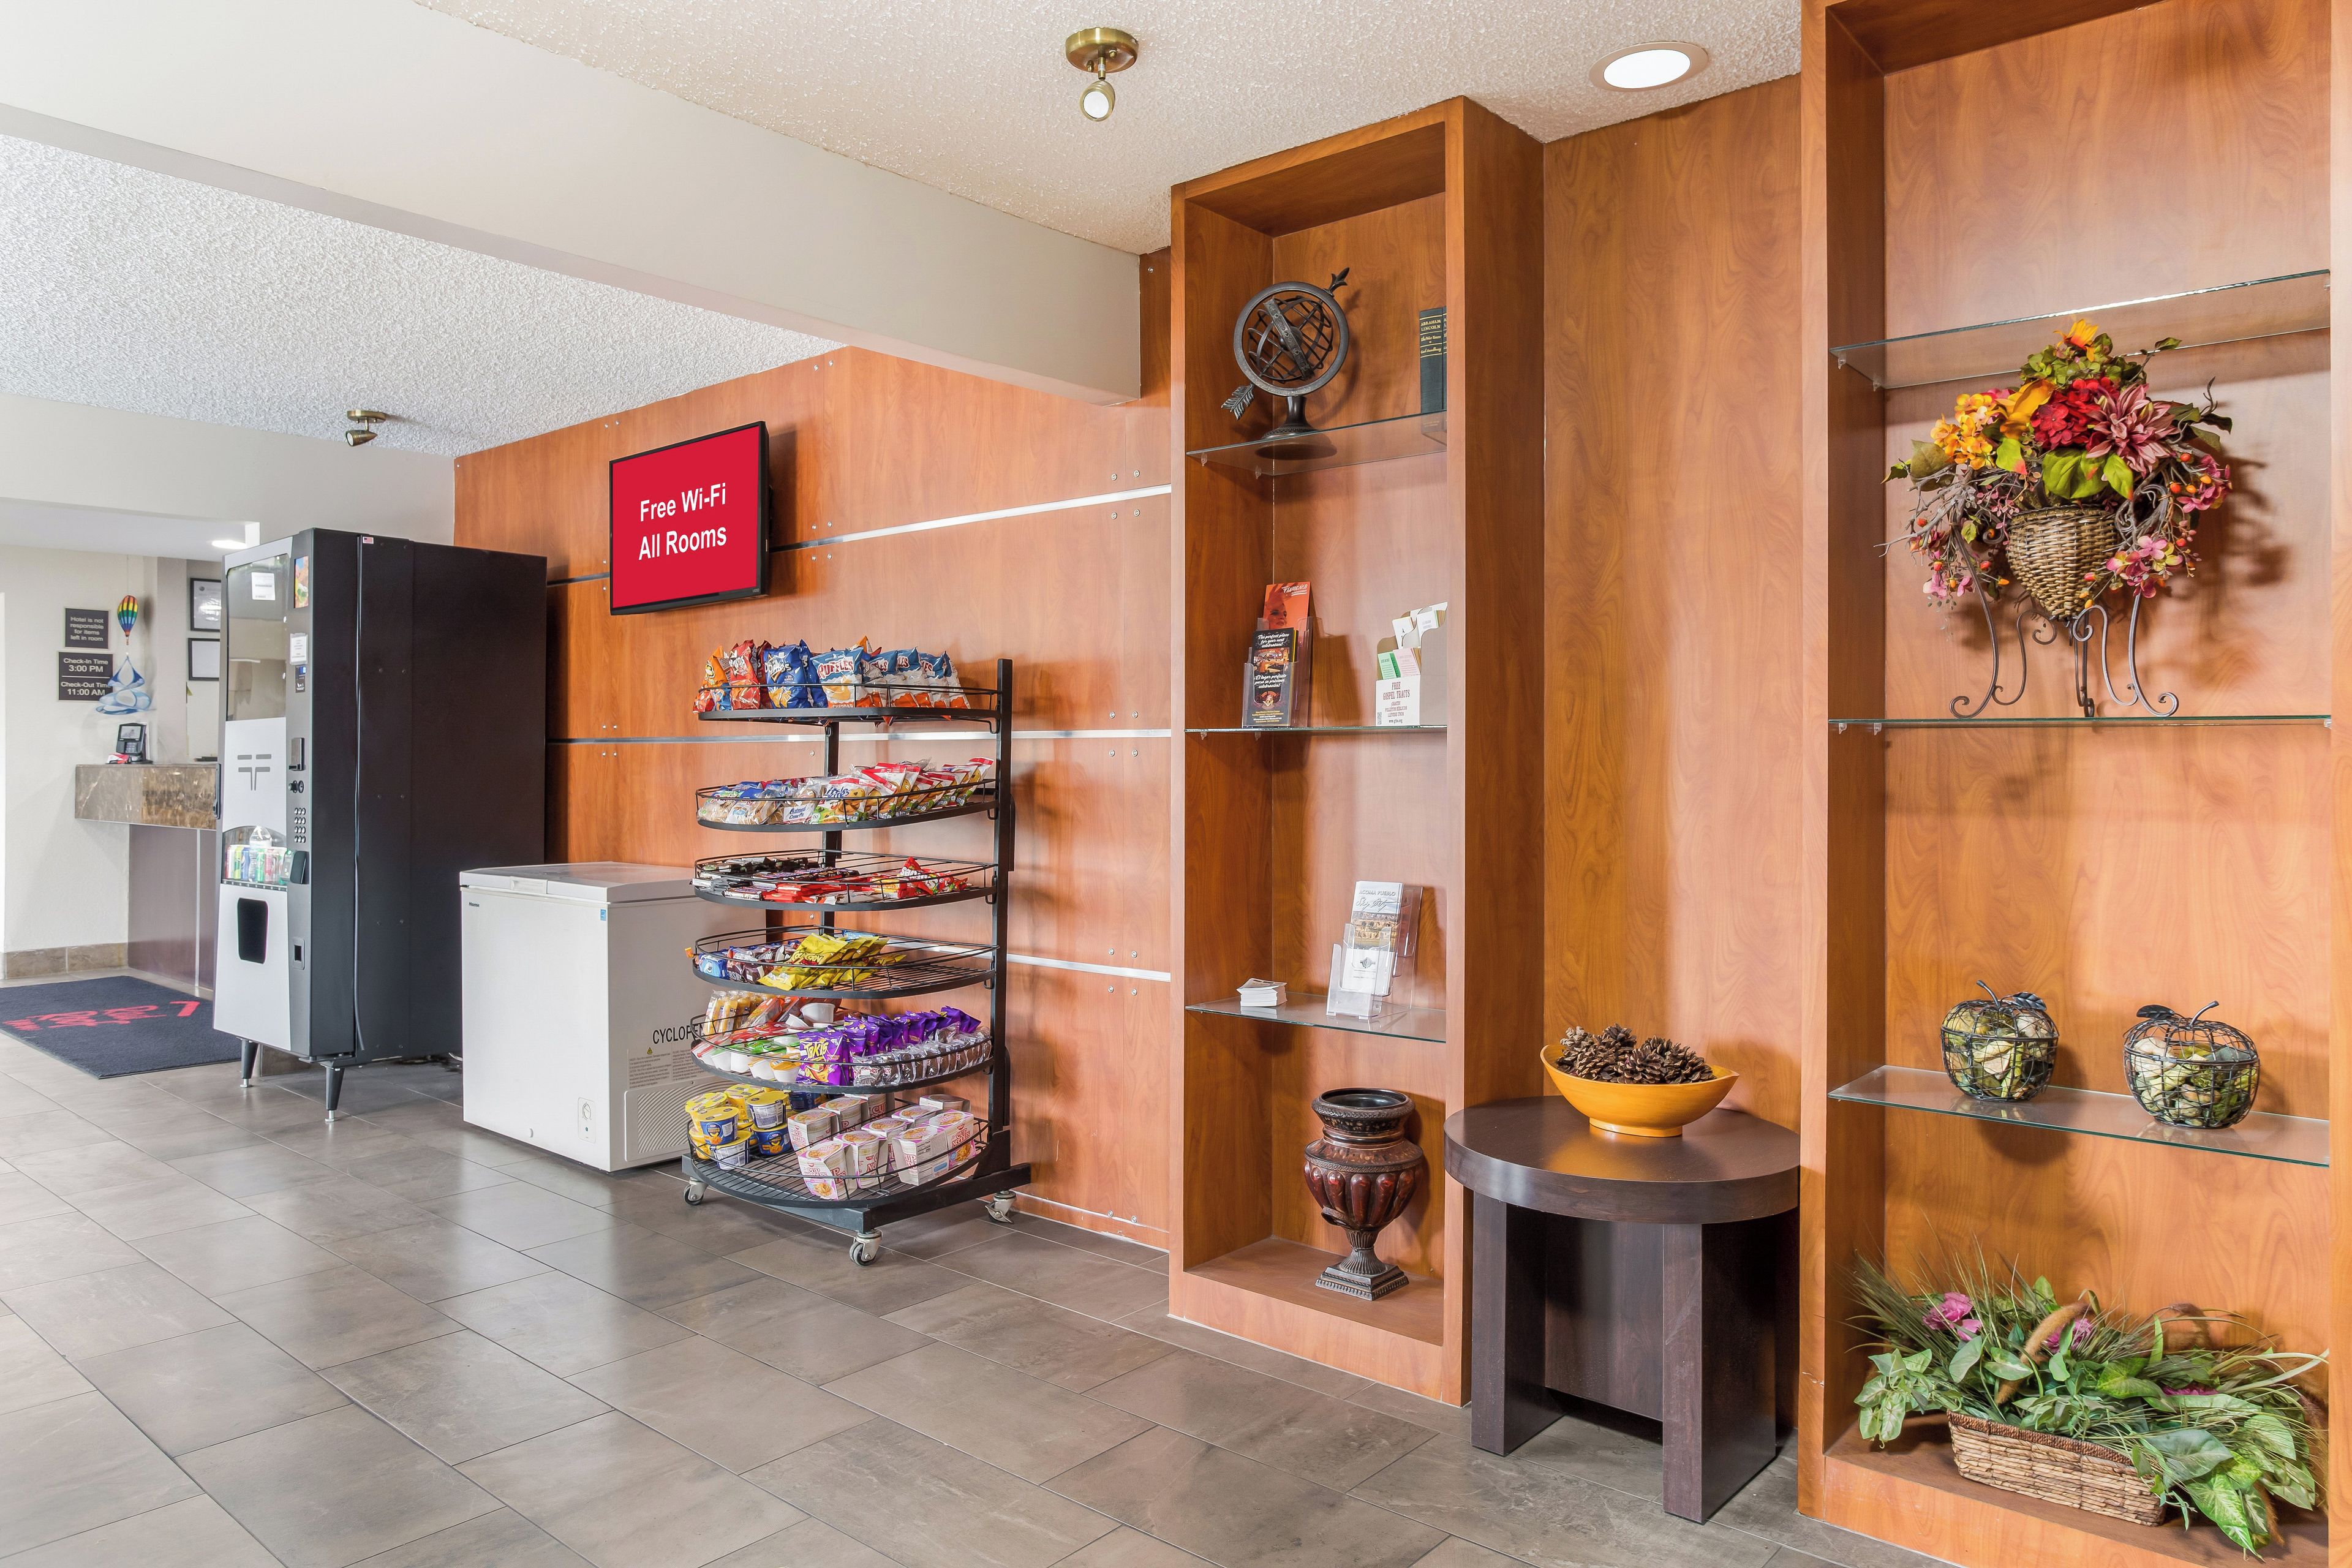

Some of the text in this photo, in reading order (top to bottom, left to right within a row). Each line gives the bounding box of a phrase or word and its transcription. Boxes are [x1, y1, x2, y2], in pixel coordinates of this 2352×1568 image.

[640, 482, 726, 522] Free Wi-Fi
[638, 526, 726, 560] All Rooms
[817, 660, 854, 680] RUFFLES
[1383, 690, 1410, 700] GOSPEL TRACTS
